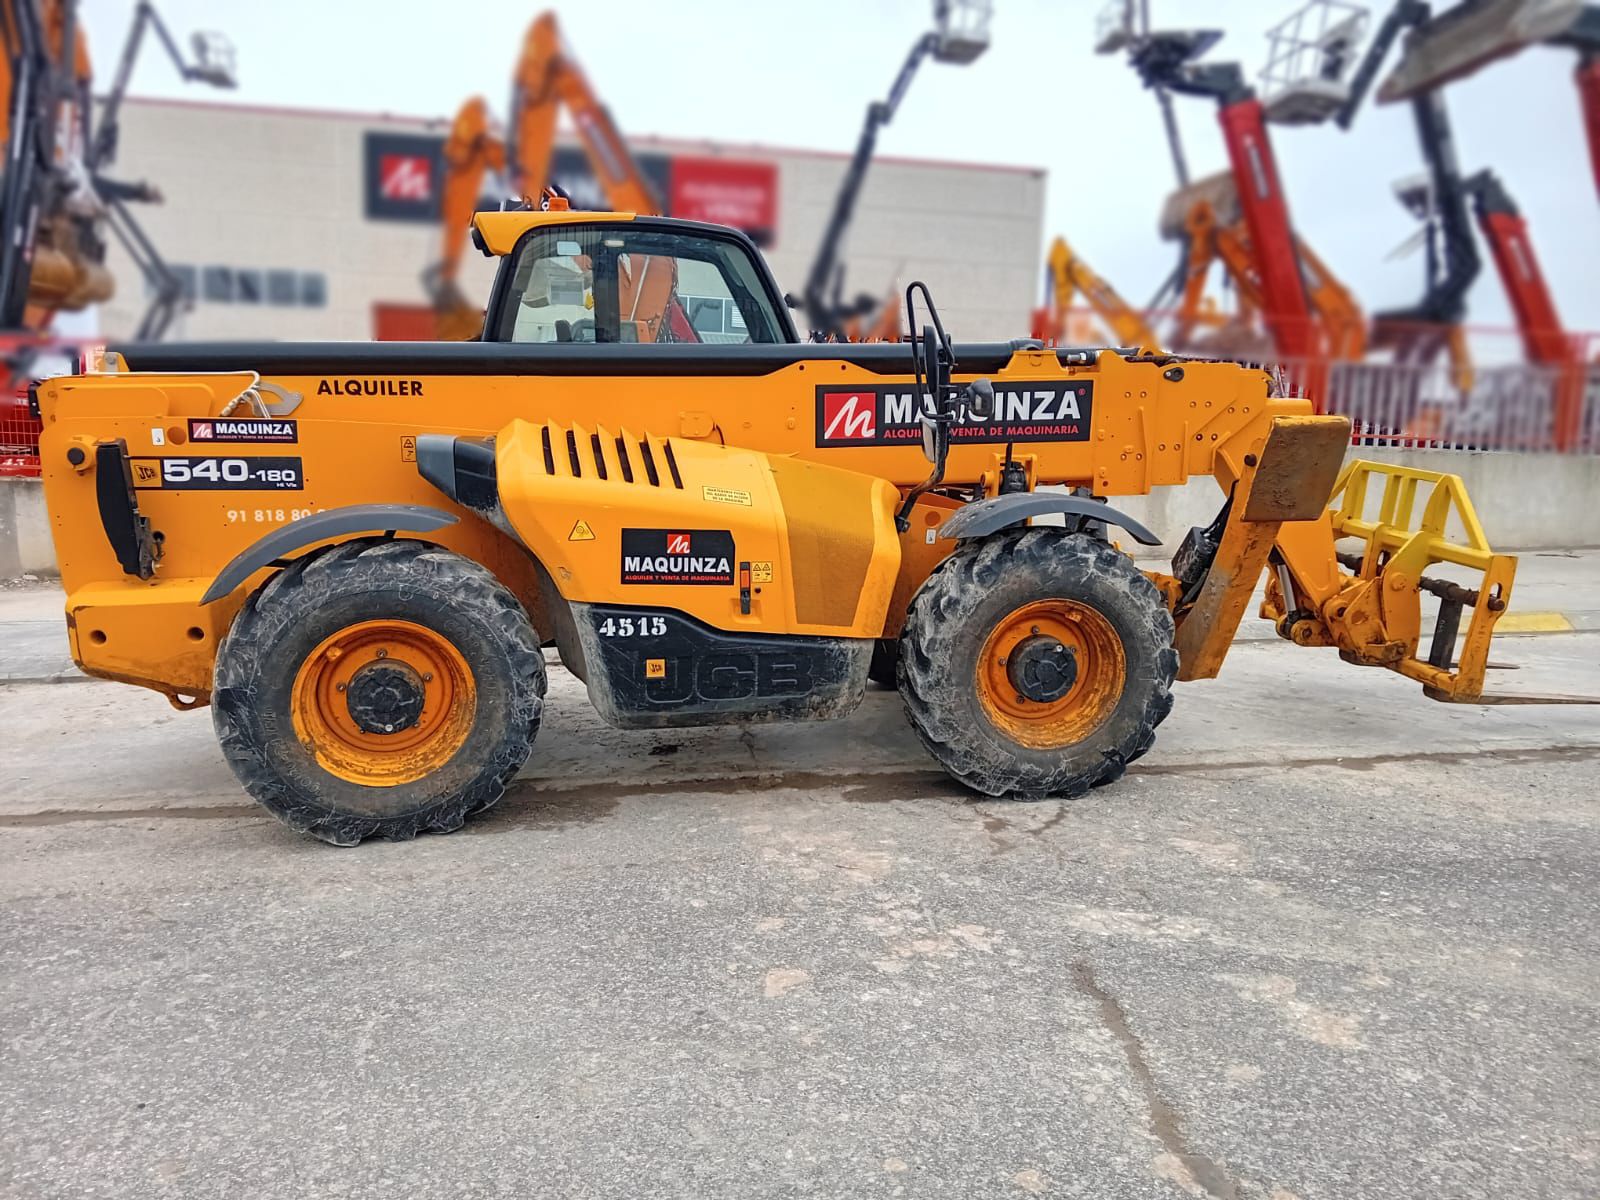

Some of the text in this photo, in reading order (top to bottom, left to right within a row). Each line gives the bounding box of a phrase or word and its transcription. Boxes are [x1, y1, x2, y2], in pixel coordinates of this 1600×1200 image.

[317, 379, 424, 396] ALQUILER
[216, 423, 293, 436] MAQUINZA
[883, 425, 1079, 438] ALQUI VENTA DE MAQUINARIA
[163, 460, 296, 482] 540-180
[227, 509, 312, 522] 91 818 80
[624, 556, 731, 574] MAQUINZA
[599, 617, 668, 637] 4515
